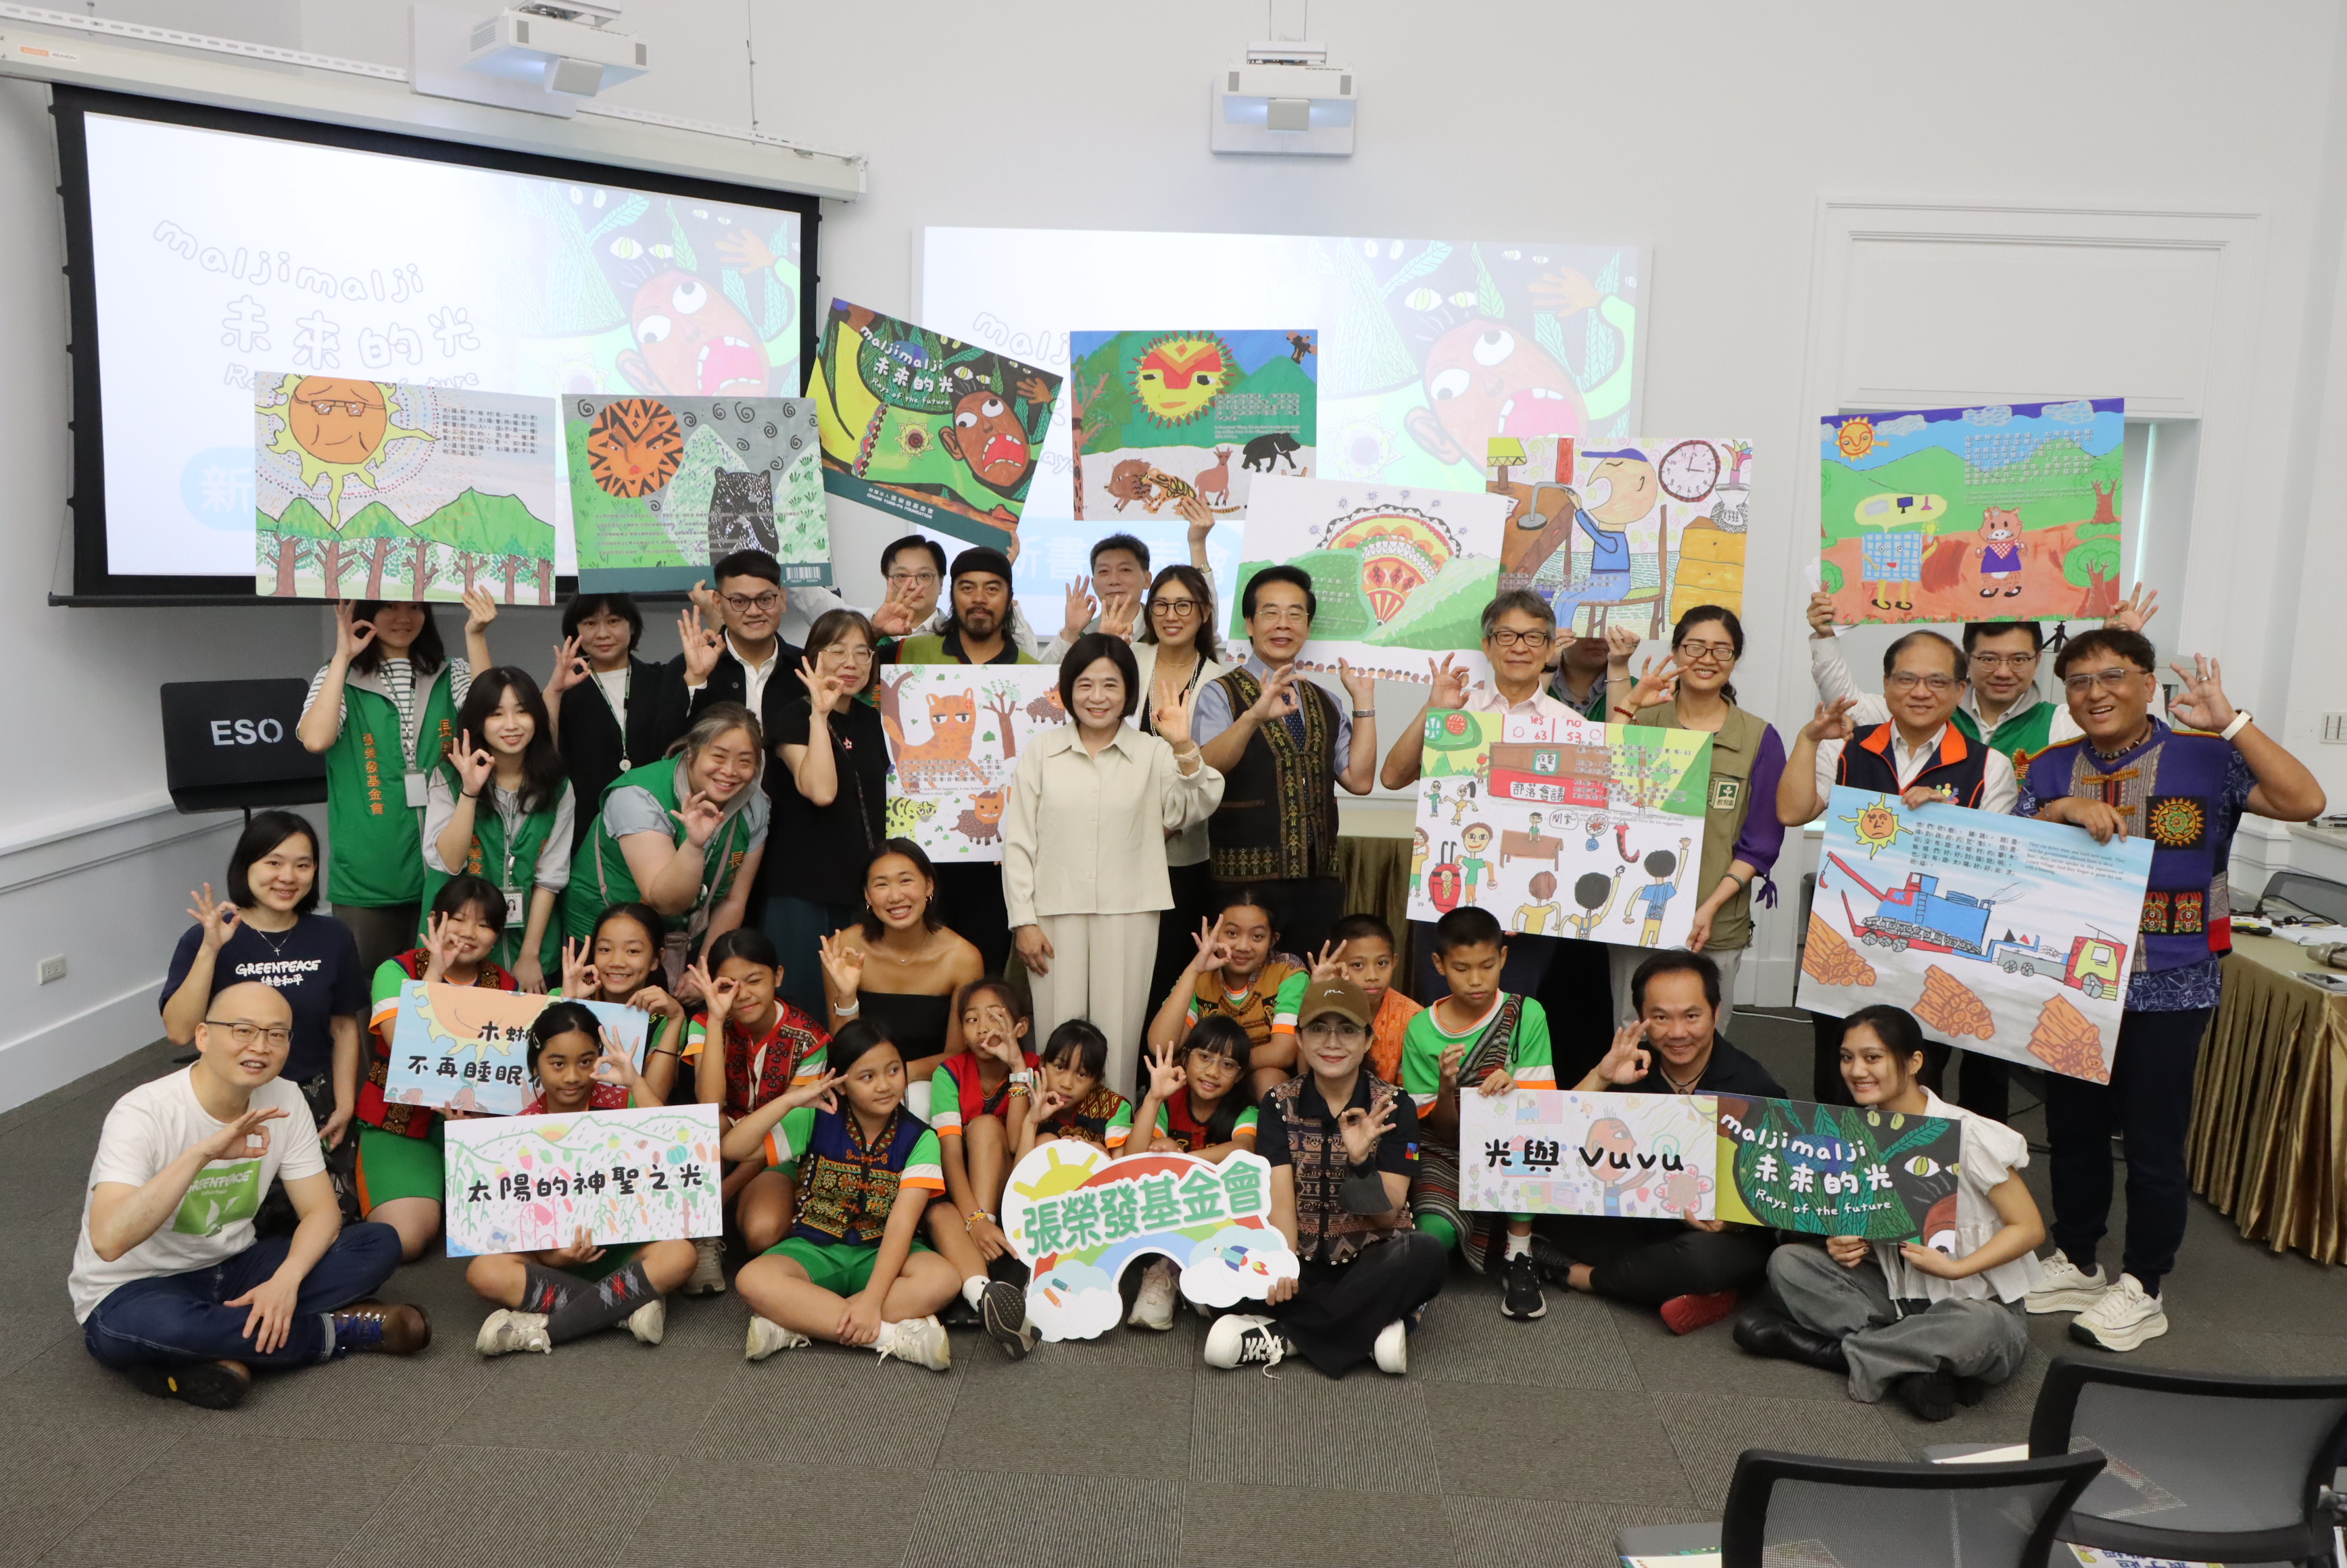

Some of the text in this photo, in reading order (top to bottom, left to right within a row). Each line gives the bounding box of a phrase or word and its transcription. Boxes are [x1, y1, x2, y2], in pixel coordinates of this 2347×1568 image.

[153, 220, 424, 303] maljimalji
[221, 295, 481, 371] 未來的光
[861, 326, 944, 372] maljimalji
[874, 357, 954, 393] 未來的光
[871, 377, 890, 394] Rays
[905, 396, 919, 404] the
[922, 396, 950, 406] future
[867, 493, 933, 519] CHANG YUNG-FA FOUNDATION
[211, 718, 283, 745] ESO
[1534, 730, 1582, 743] 63 53
[1566, 719, 1582, 728] no
[363, 733, 384, 815] 張榮發基金會
[1513, 782, 1565, 802] 部落會議
[2044, 851, 2068, 859] government
[235, 960, 322, 977] GREENPEACE
[261, 974, 304, 987] 綠色和平
[1720, 1114, 1866, 1162] maljimalji
[468, 1163, 703, 1204] 太陽的神聖之光
[1753, 1153, 1893, 1194] 未來的光
[1022, 1160, 1263, 1256] 張榮發基金會
[1756, 1189, 1892, 1216] Rays of the future
